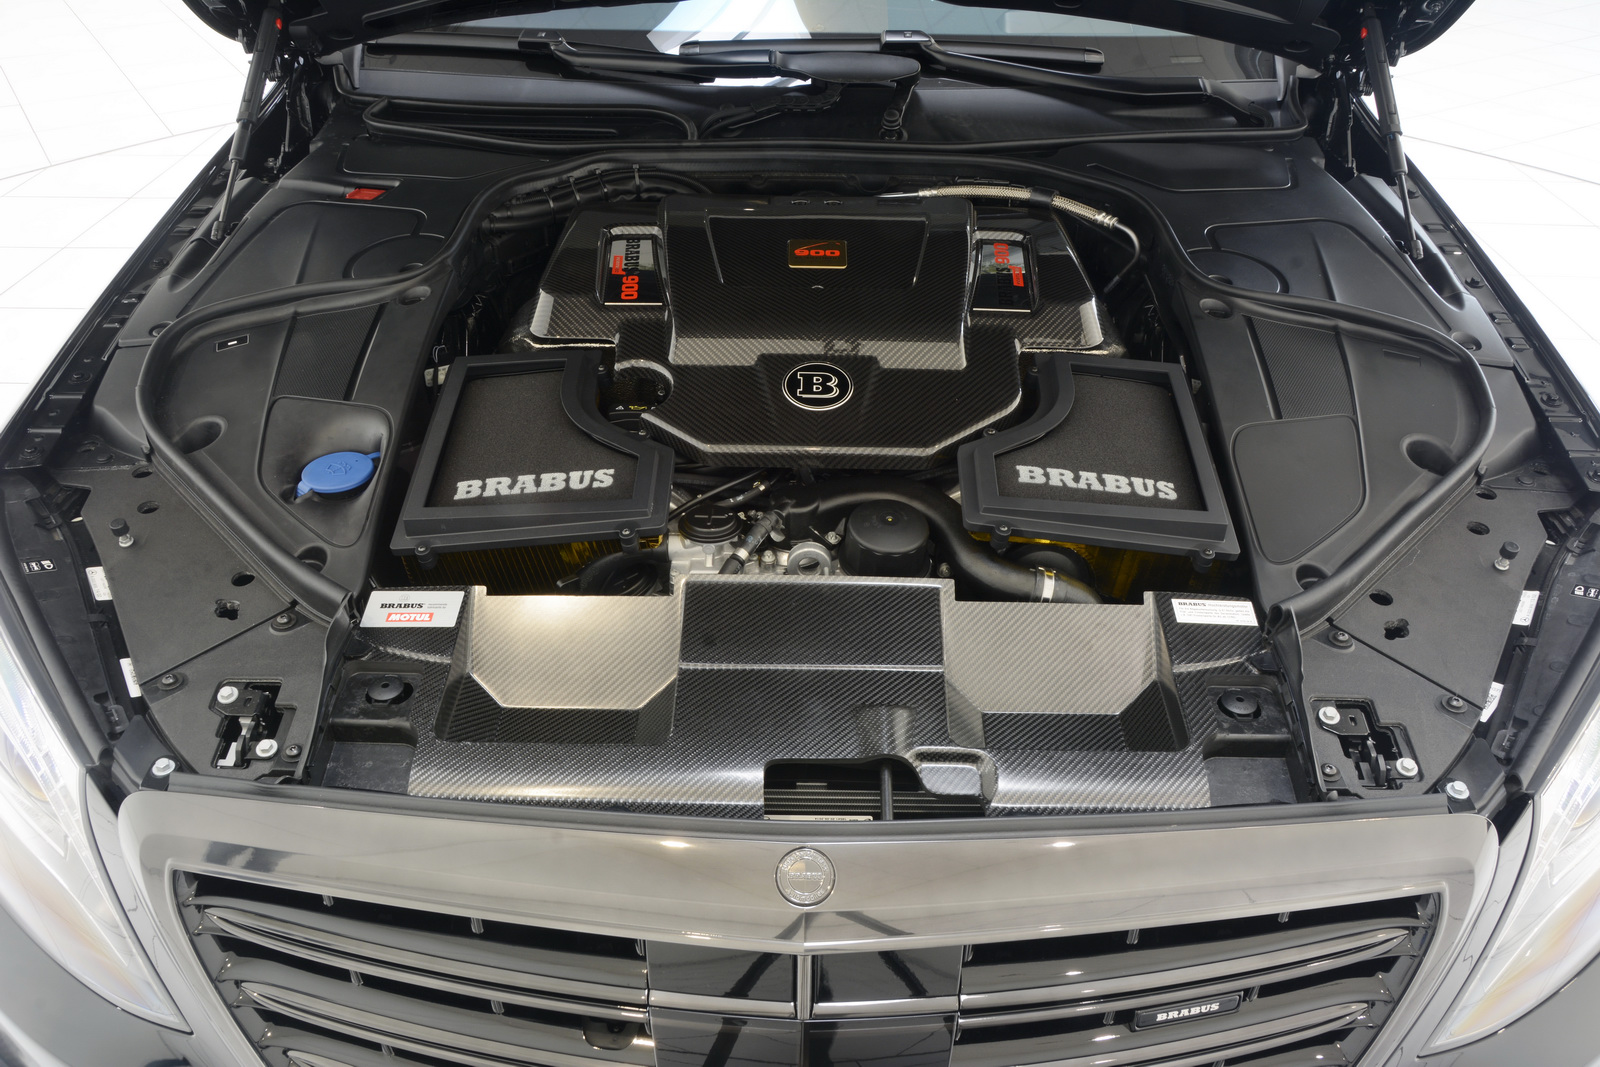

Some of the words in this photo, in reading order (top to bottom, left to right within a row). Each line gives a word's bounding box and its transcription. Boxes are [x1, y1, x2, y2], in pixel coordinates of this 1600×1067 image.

[794, 248, 840, 257] 900
[993, 242, 1010, 264] 900
[621, 275, 639, 300] 900
[797, 371, 840, 399] B
[453, 469, 615, 500] BRABUS
[1015, 465, 1178, 500] BRABUS
[387, 613, 431, 621] MOTUL
[1156, 1002, 1220, 1022] BRABUS
